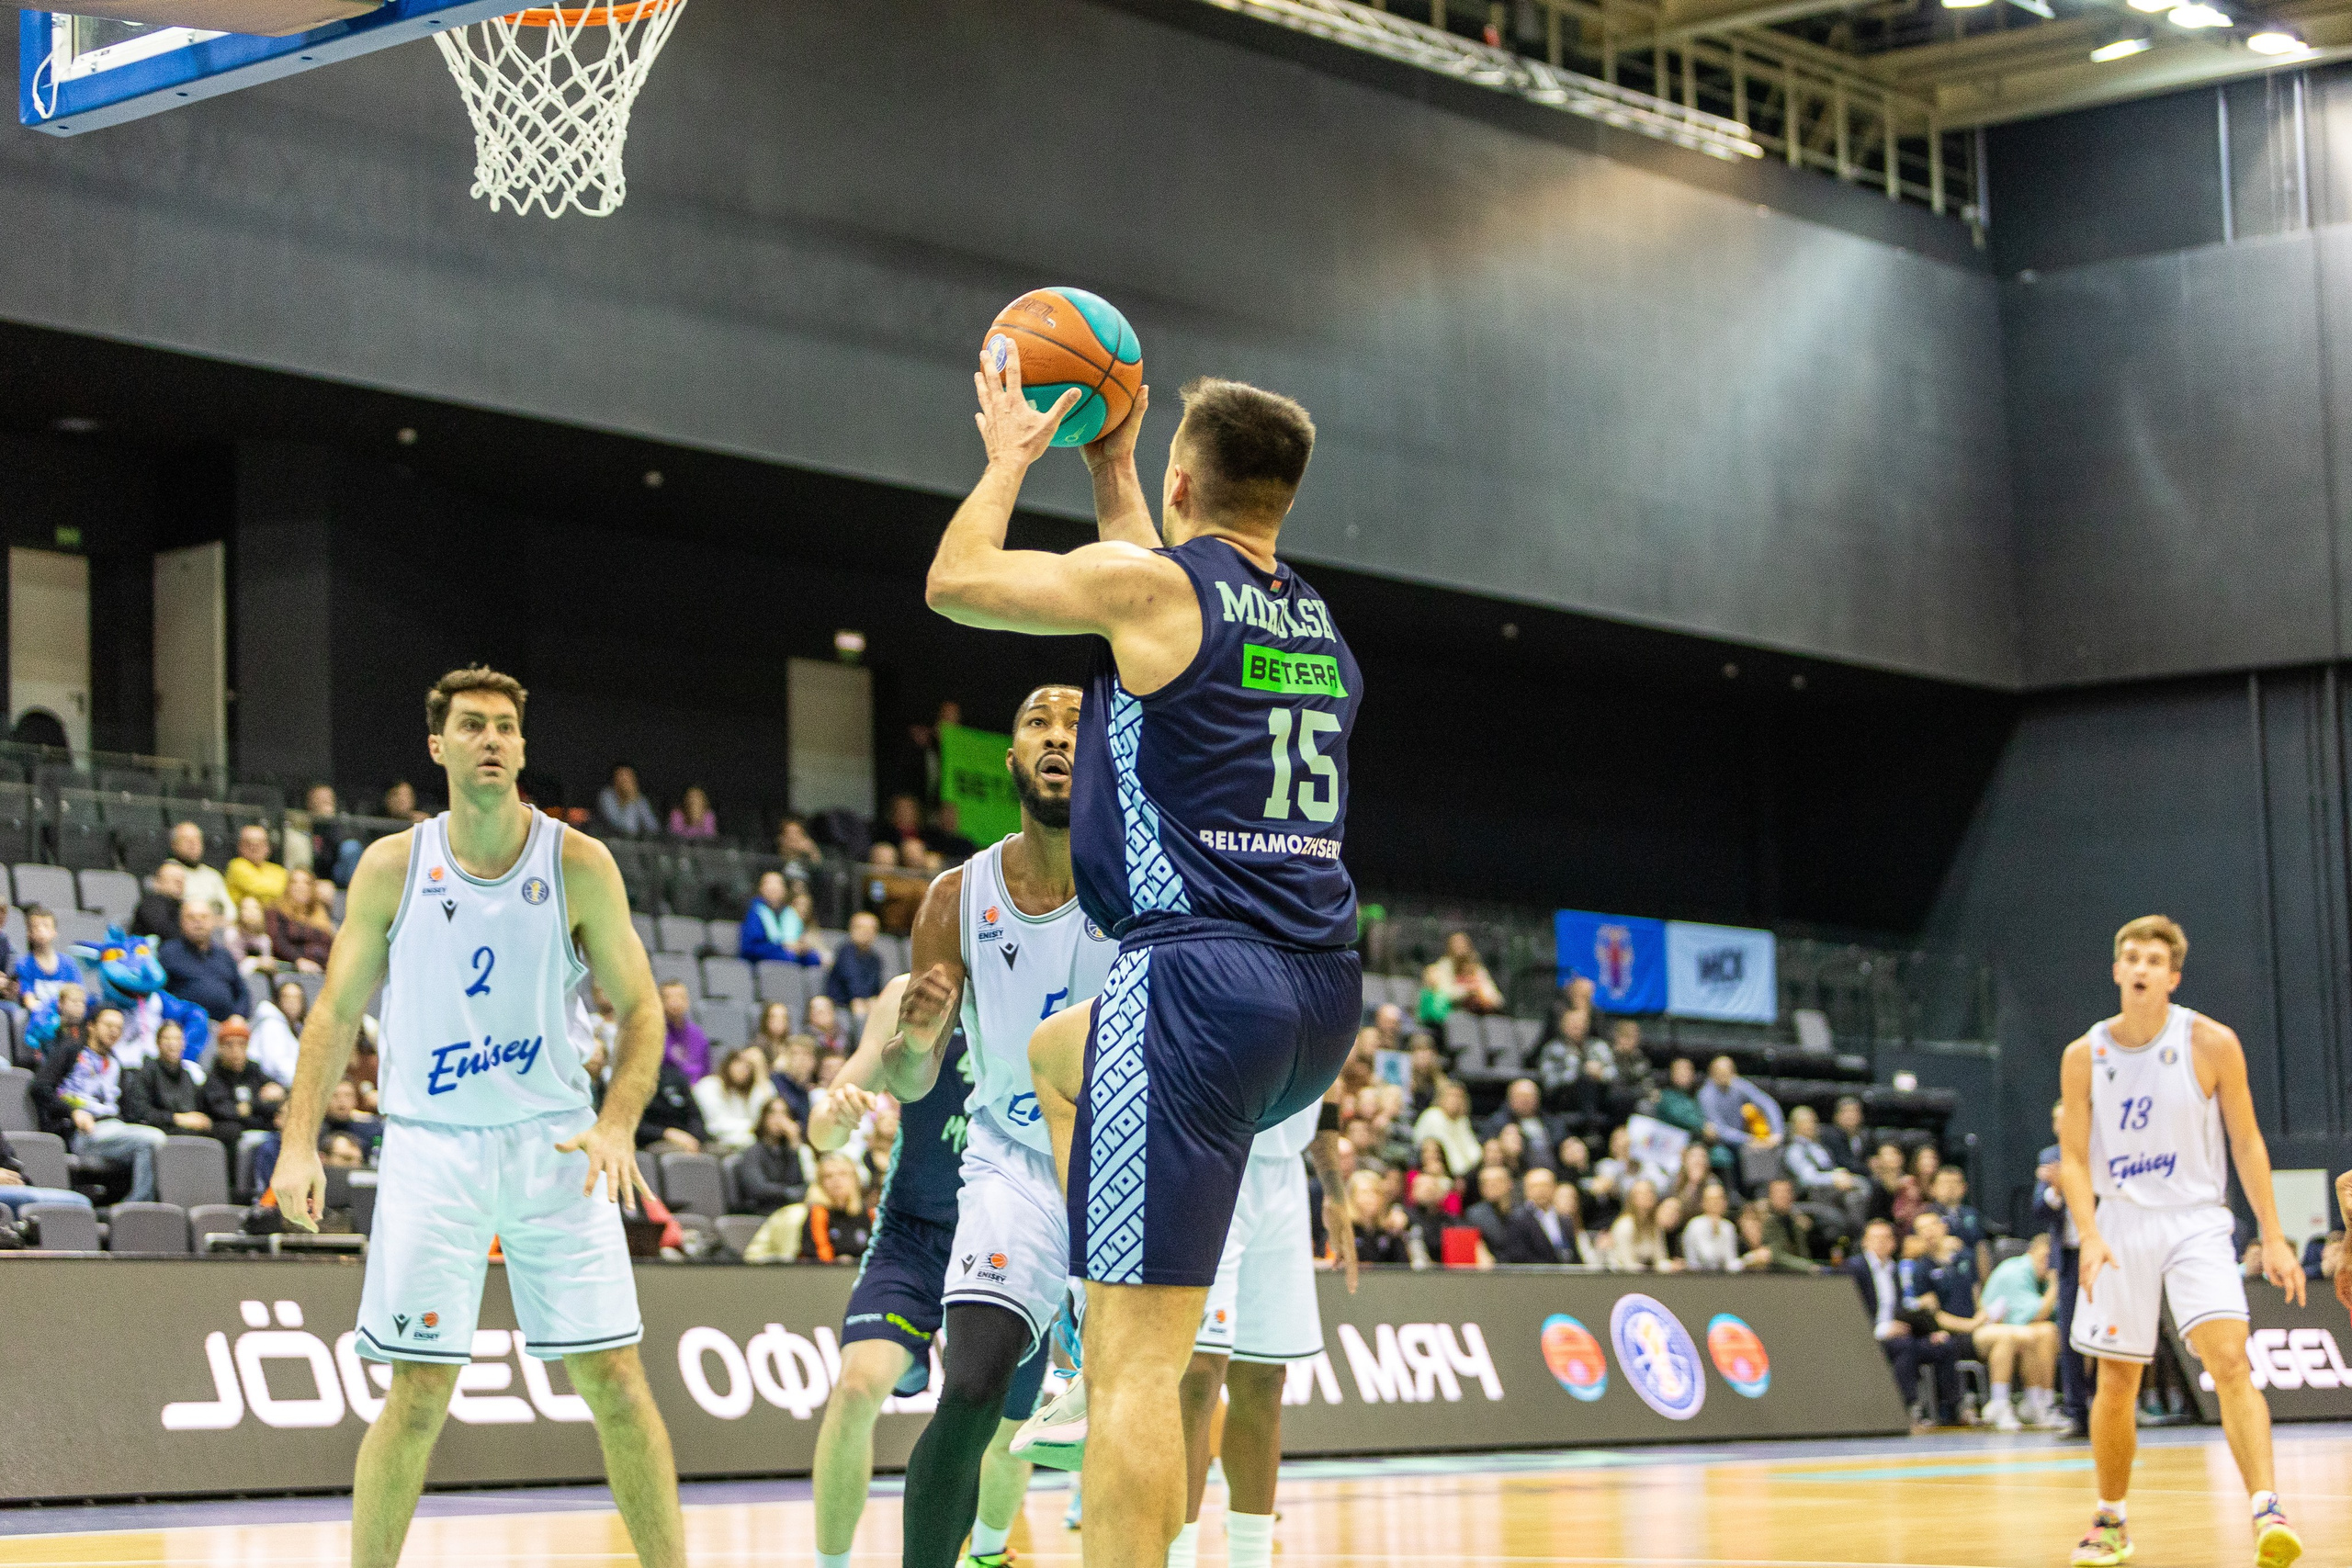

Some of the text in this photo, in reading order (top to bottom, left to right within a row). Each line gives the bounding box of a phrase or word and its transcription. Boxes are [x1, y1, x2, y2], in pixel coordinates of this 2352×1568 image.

[1250, 655, 1338, 689] BETERA
[1263, 707, 1342, 823] 15
[464, 946, 495, 998] 2
[427, 1034, 543, 1096] Enisey
[2120, 1096, 2153, 1130] 13
[977, 1271, 1007, 1282] ENISEY
[1337, 1322, 1505, 1403] МЯЧ
[2199, 1328, 2352, 1391] GEL
